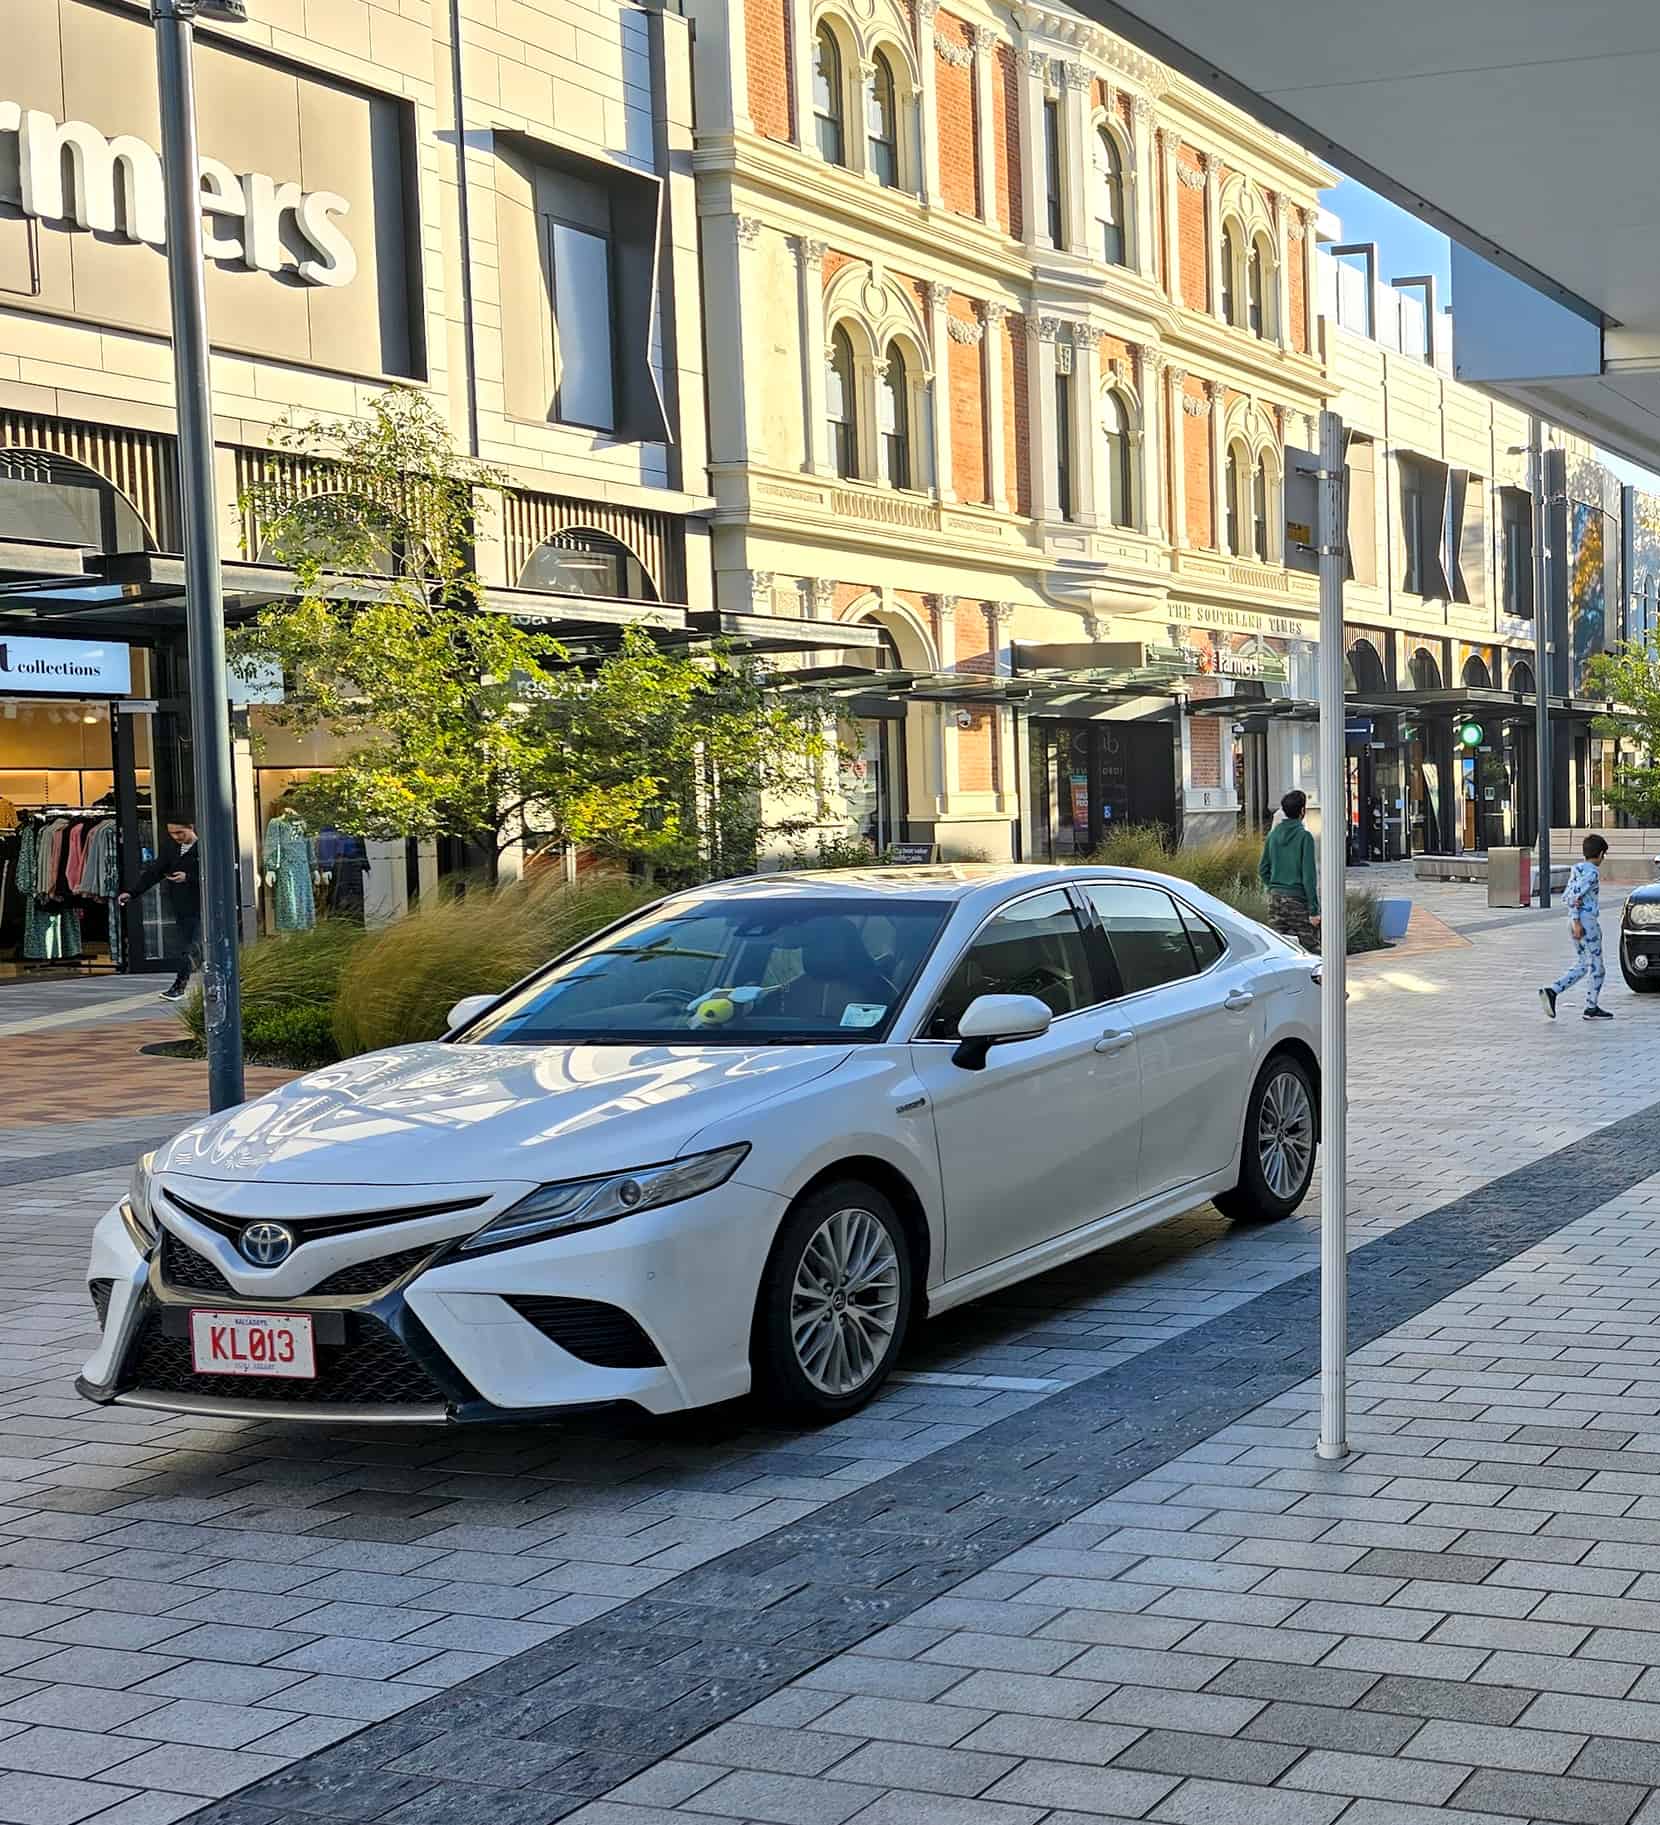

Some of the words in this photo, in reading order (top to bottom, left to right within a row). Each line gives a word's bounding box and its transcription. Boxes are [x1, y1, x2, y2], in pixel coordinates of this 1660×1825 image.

[1167, 603, 1192, 620] THE
[1196, 608, 1263, 630] SOUTHLAND
[1268, 617, 1302, 635] TIMES
[17, 659, 102, 677] collections
[209, 1326, 296, 1363] KL013
